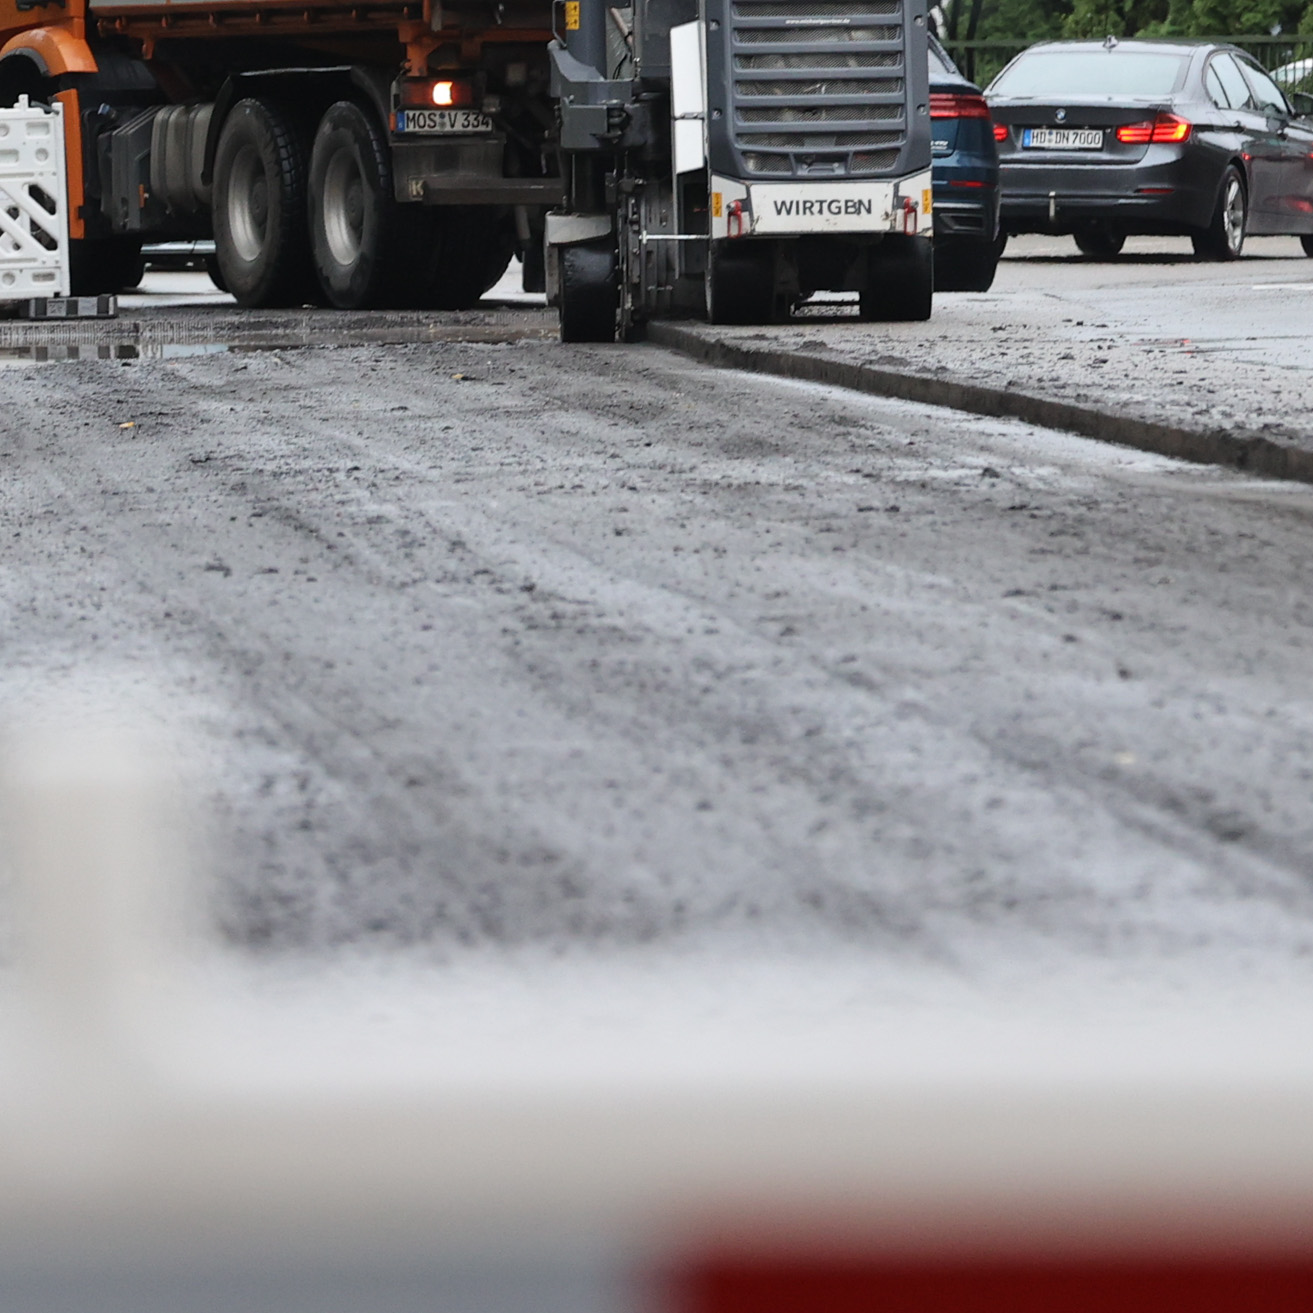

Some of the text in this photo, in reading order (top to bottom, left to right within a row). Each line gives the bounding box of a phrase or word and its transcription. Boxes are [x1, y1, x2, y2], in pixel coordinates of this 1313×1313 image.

[407, 112, 490, 128] MOS V 334
[1032, 131, 1100, 145] HD DN 7000
